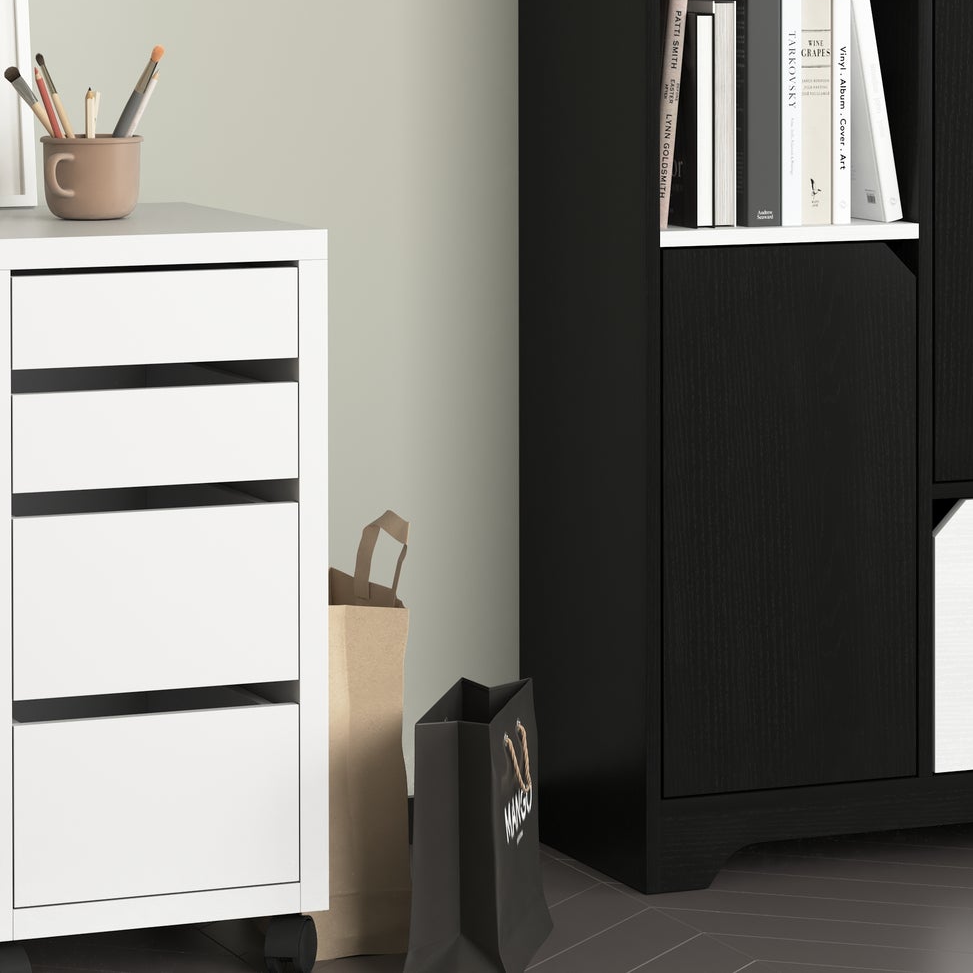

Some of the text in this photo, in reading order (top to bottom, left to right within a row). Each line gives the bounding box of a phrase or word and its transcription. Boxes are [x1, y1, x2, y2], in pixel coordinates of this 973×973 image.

[671, 10, 682, 69] PATTI SMITH
[788, 30, 797, 109] TARKOVSKY
[801, 48, 831, 57] GRAPES
[839, 46, 847, 170] Vinyl Album Cover Art
[660, 114, 672, 198] LYNN GOLDSMITH
[504, 784, 533, 845] MANGO
